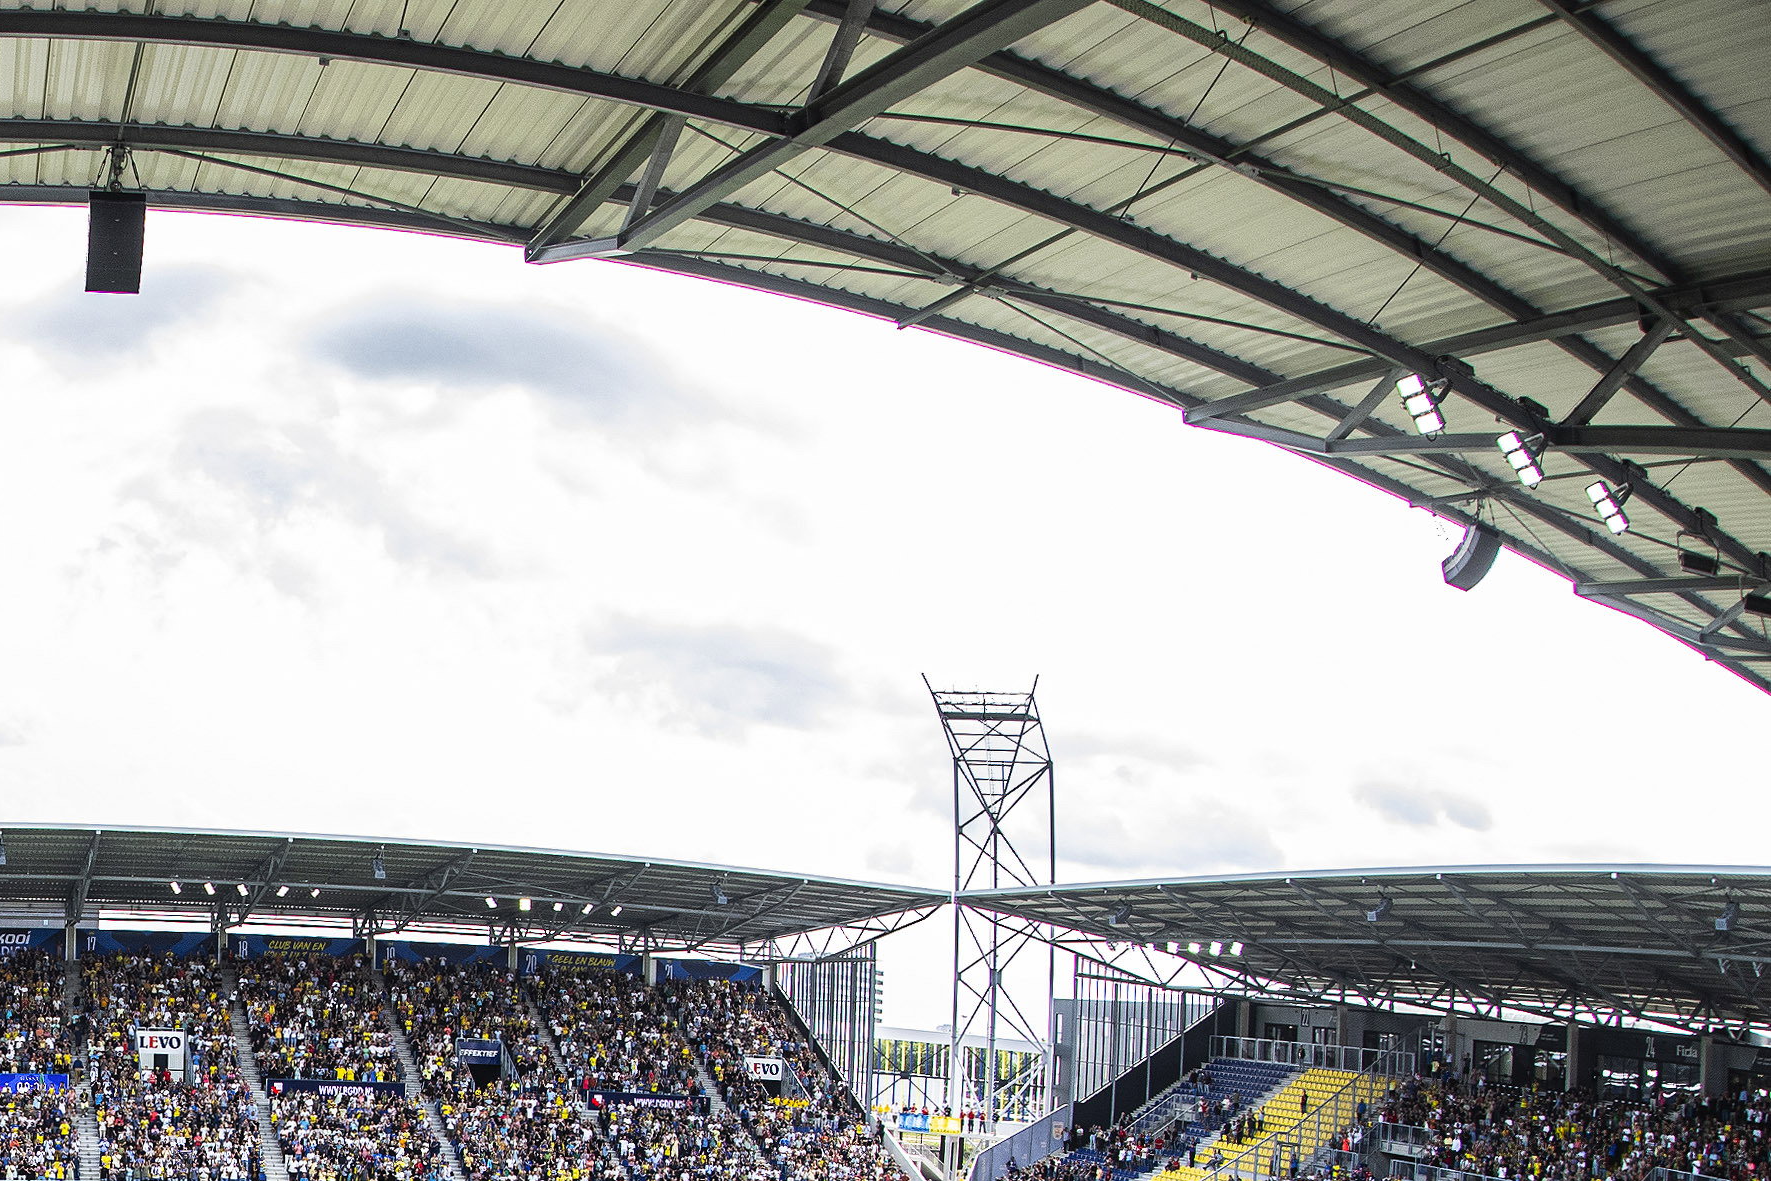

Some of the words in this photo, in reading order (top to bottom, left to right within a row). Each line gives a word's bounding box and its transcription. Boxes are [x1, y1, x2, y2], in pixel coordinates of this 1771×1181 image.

[87, 936, 96, 950] 17
[238, 940, 248, 959] 18
[268, 940, 291, 950] CLUB
[293, 941, 311, 950] VAN
[312, 942, 326, 951] EN
[525, 955, 537, 974] 20
[551, 955, 573, 964] GEEL
[587, 957, 616, 967] BLAUW
[139, 1035, 182, 1049] LEVO
[1645, 1036, 1656, 1058] 24
[747, 1061, 779, 1076] EVO
